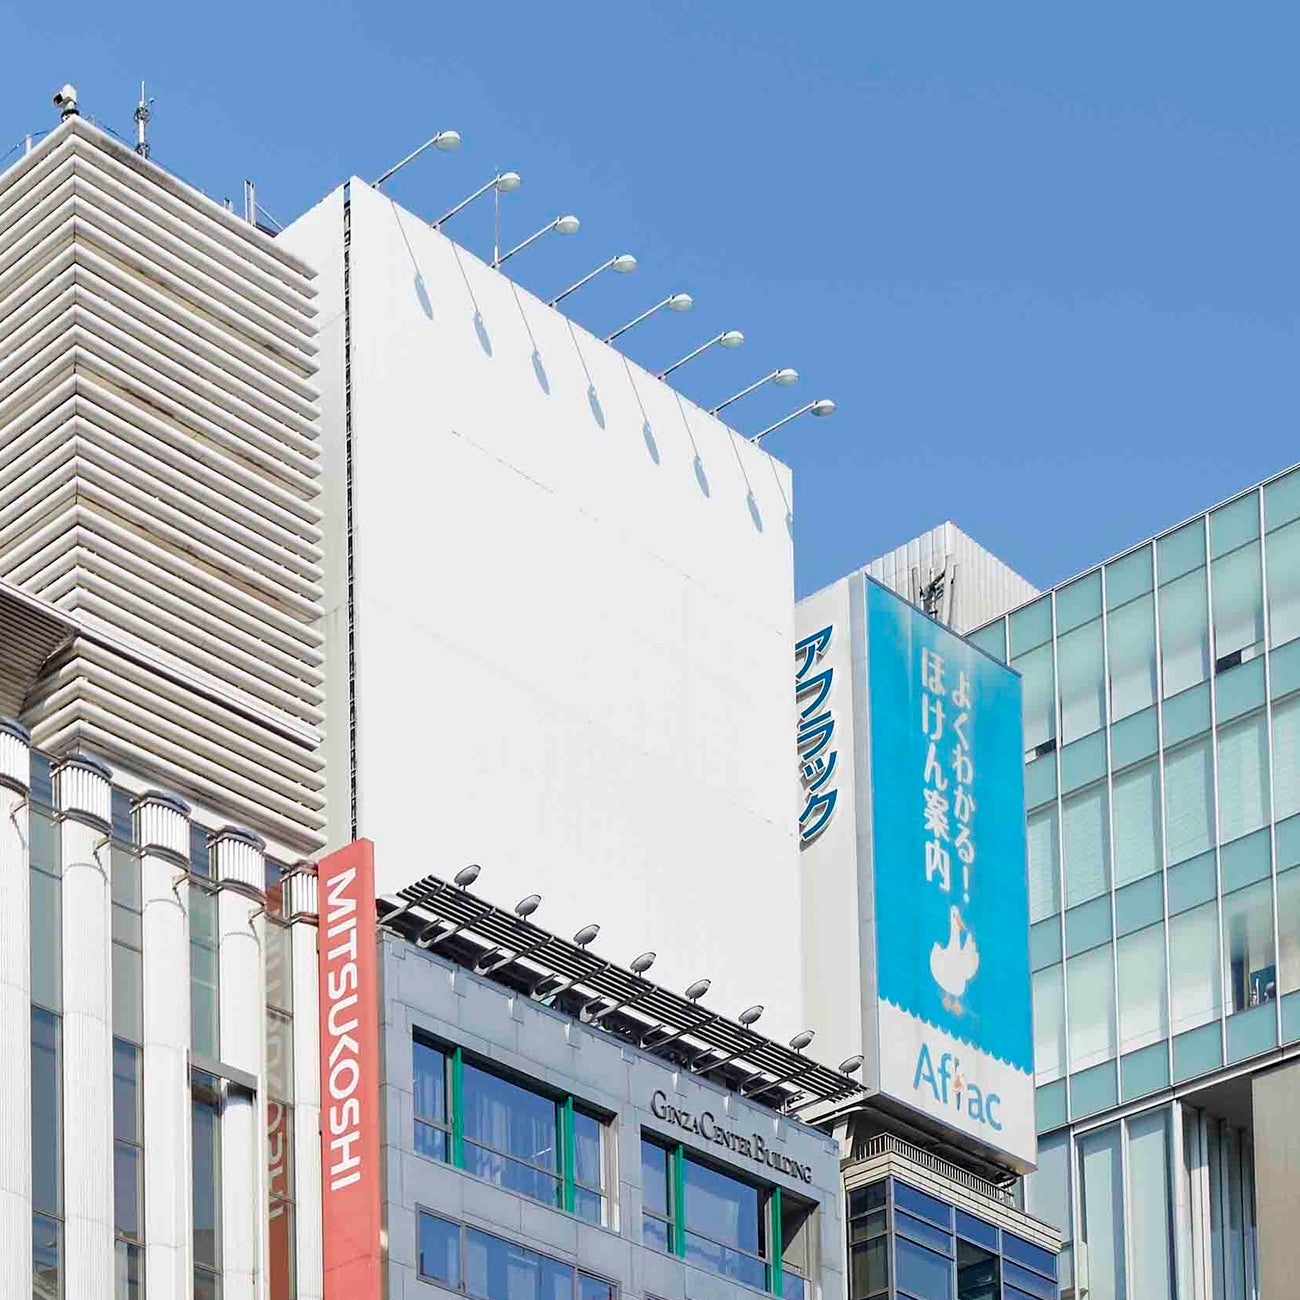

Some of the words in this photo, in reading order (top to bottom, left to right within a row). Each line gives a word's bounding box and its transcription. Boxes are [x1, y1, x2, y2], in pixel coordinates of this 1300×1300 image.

[795, 624, 837, 843] アフラック
[921, 646, 951, 892] ほけん案内
[325, 866, 362, 1192] MITSUKOSHI
